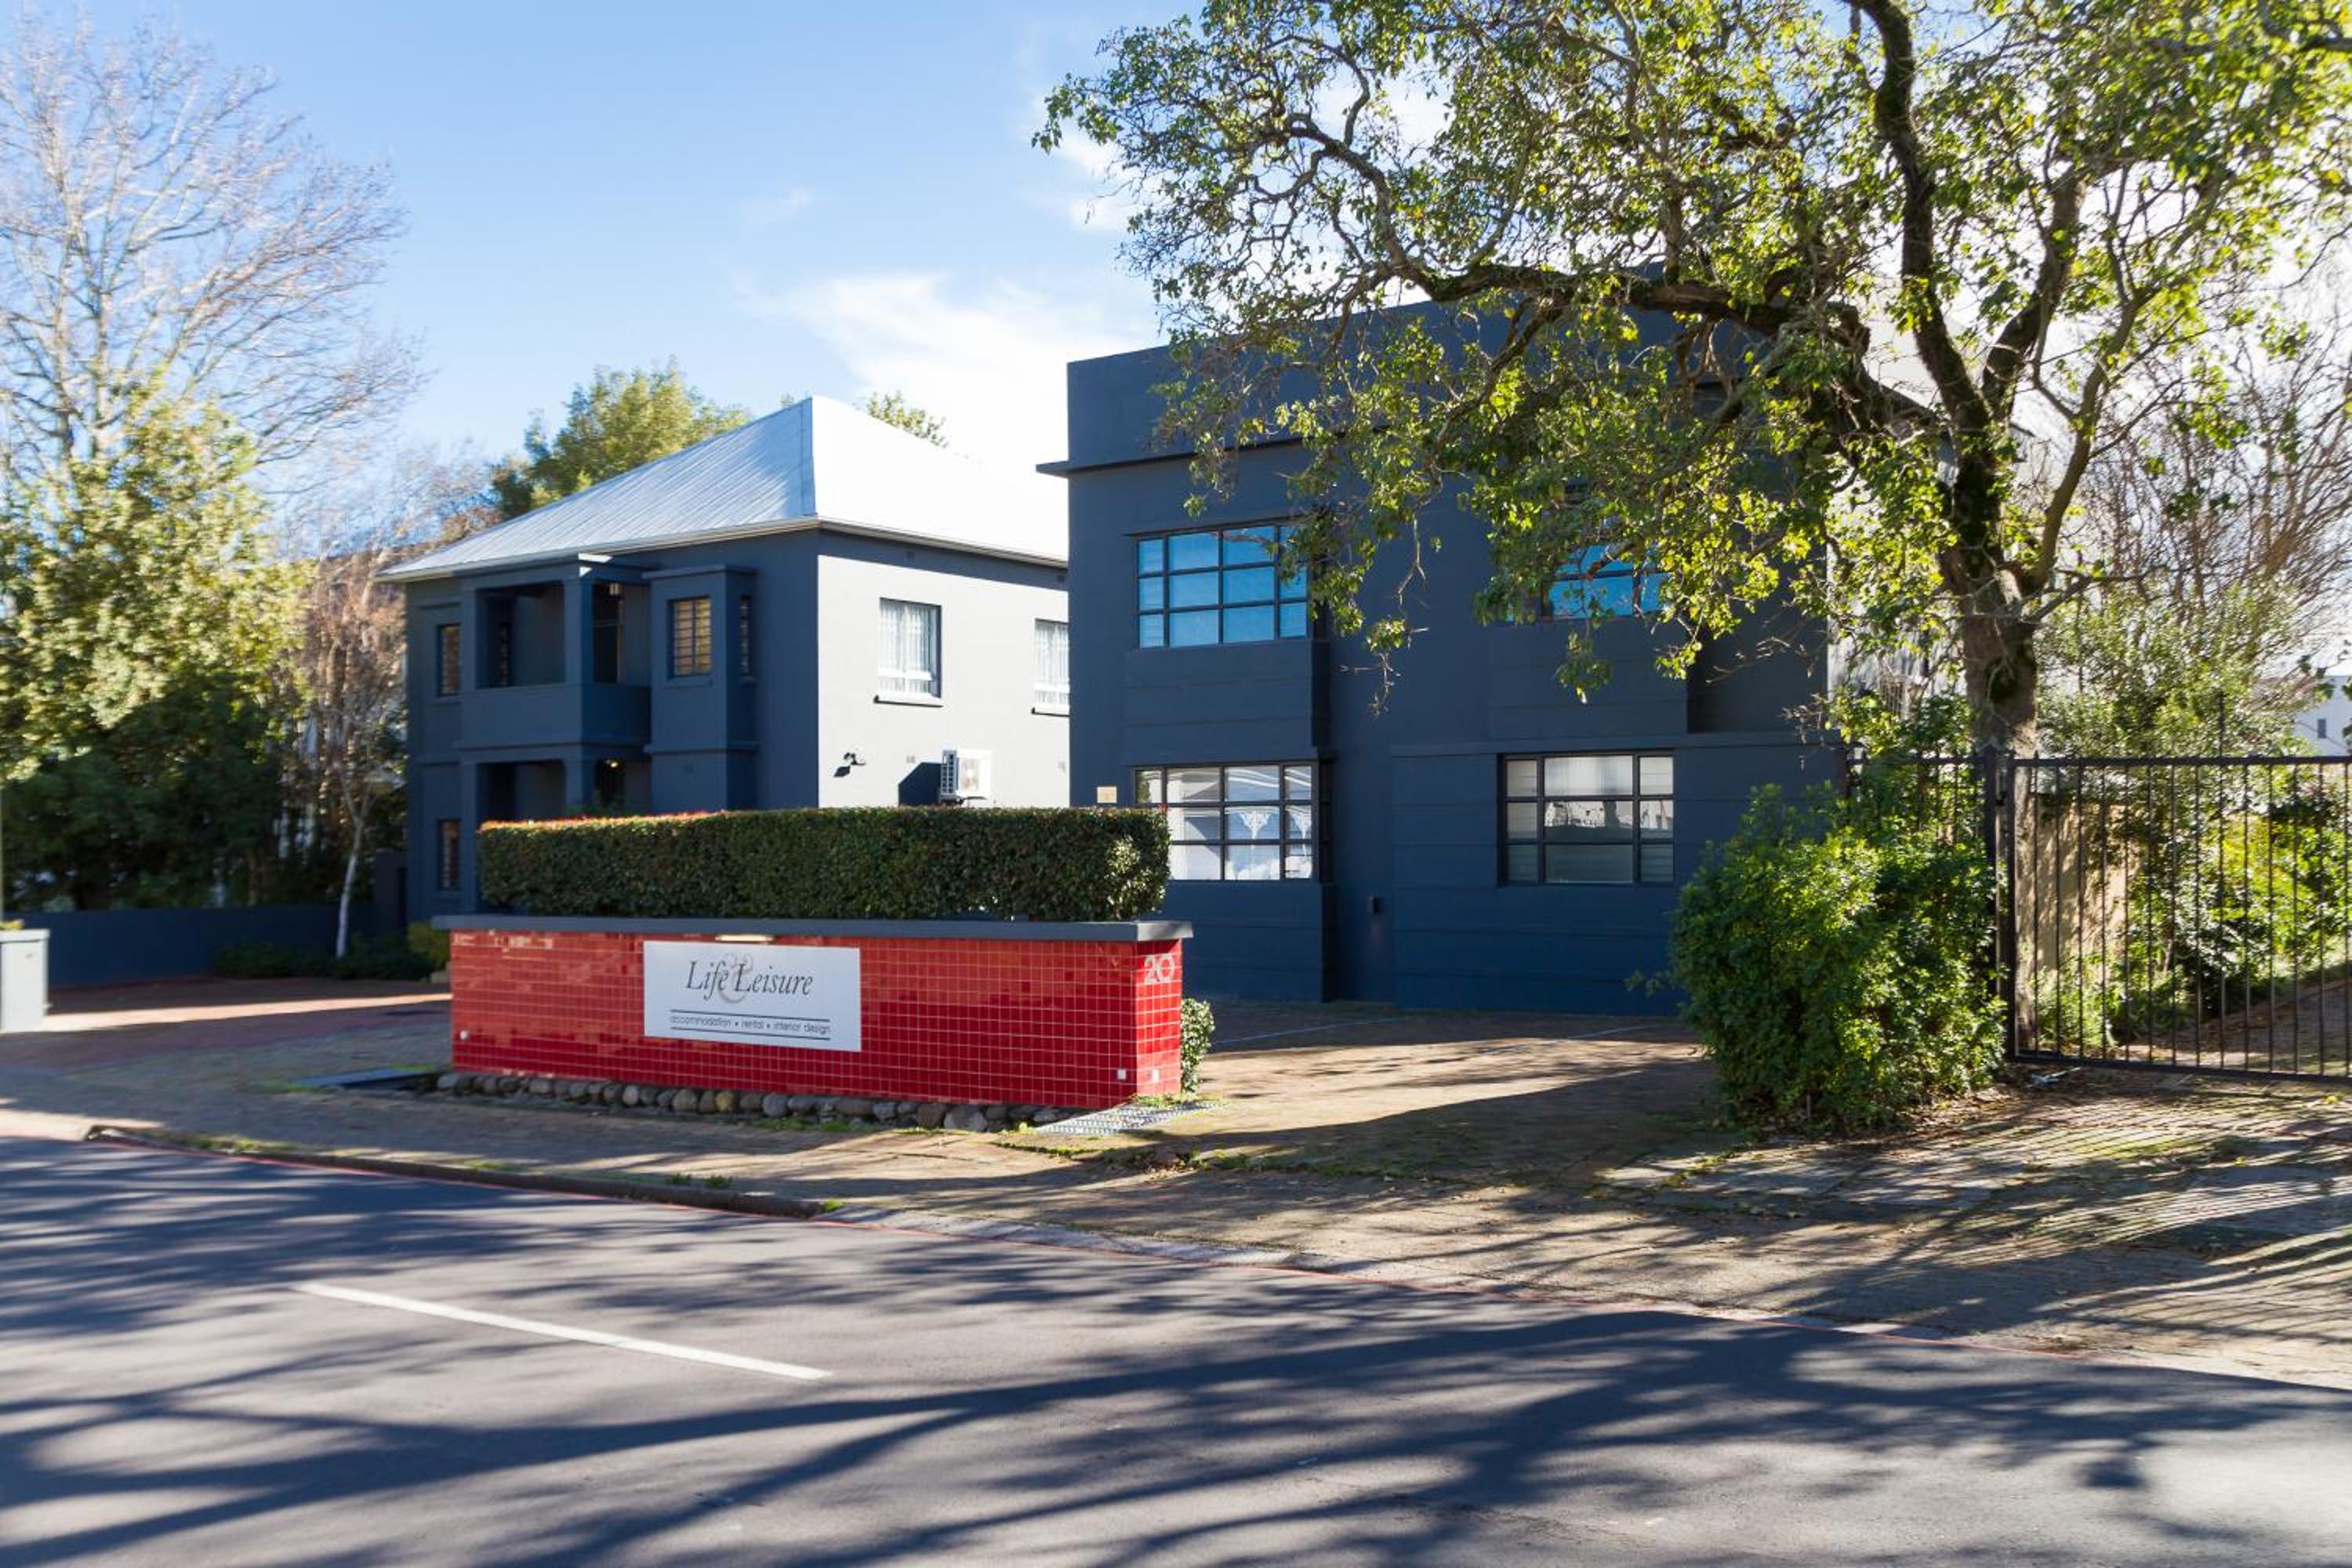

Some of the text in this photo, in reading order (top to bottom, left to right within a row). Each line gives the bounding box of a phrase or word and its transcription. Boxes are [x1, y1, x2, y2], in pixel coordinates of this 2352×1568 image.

[684, 960, 729, 1000] Life
[734, 964, 814, 996] Leisure
[1144, 953, 1175, 984] 20
[804, 1022, 830, 1036] design
